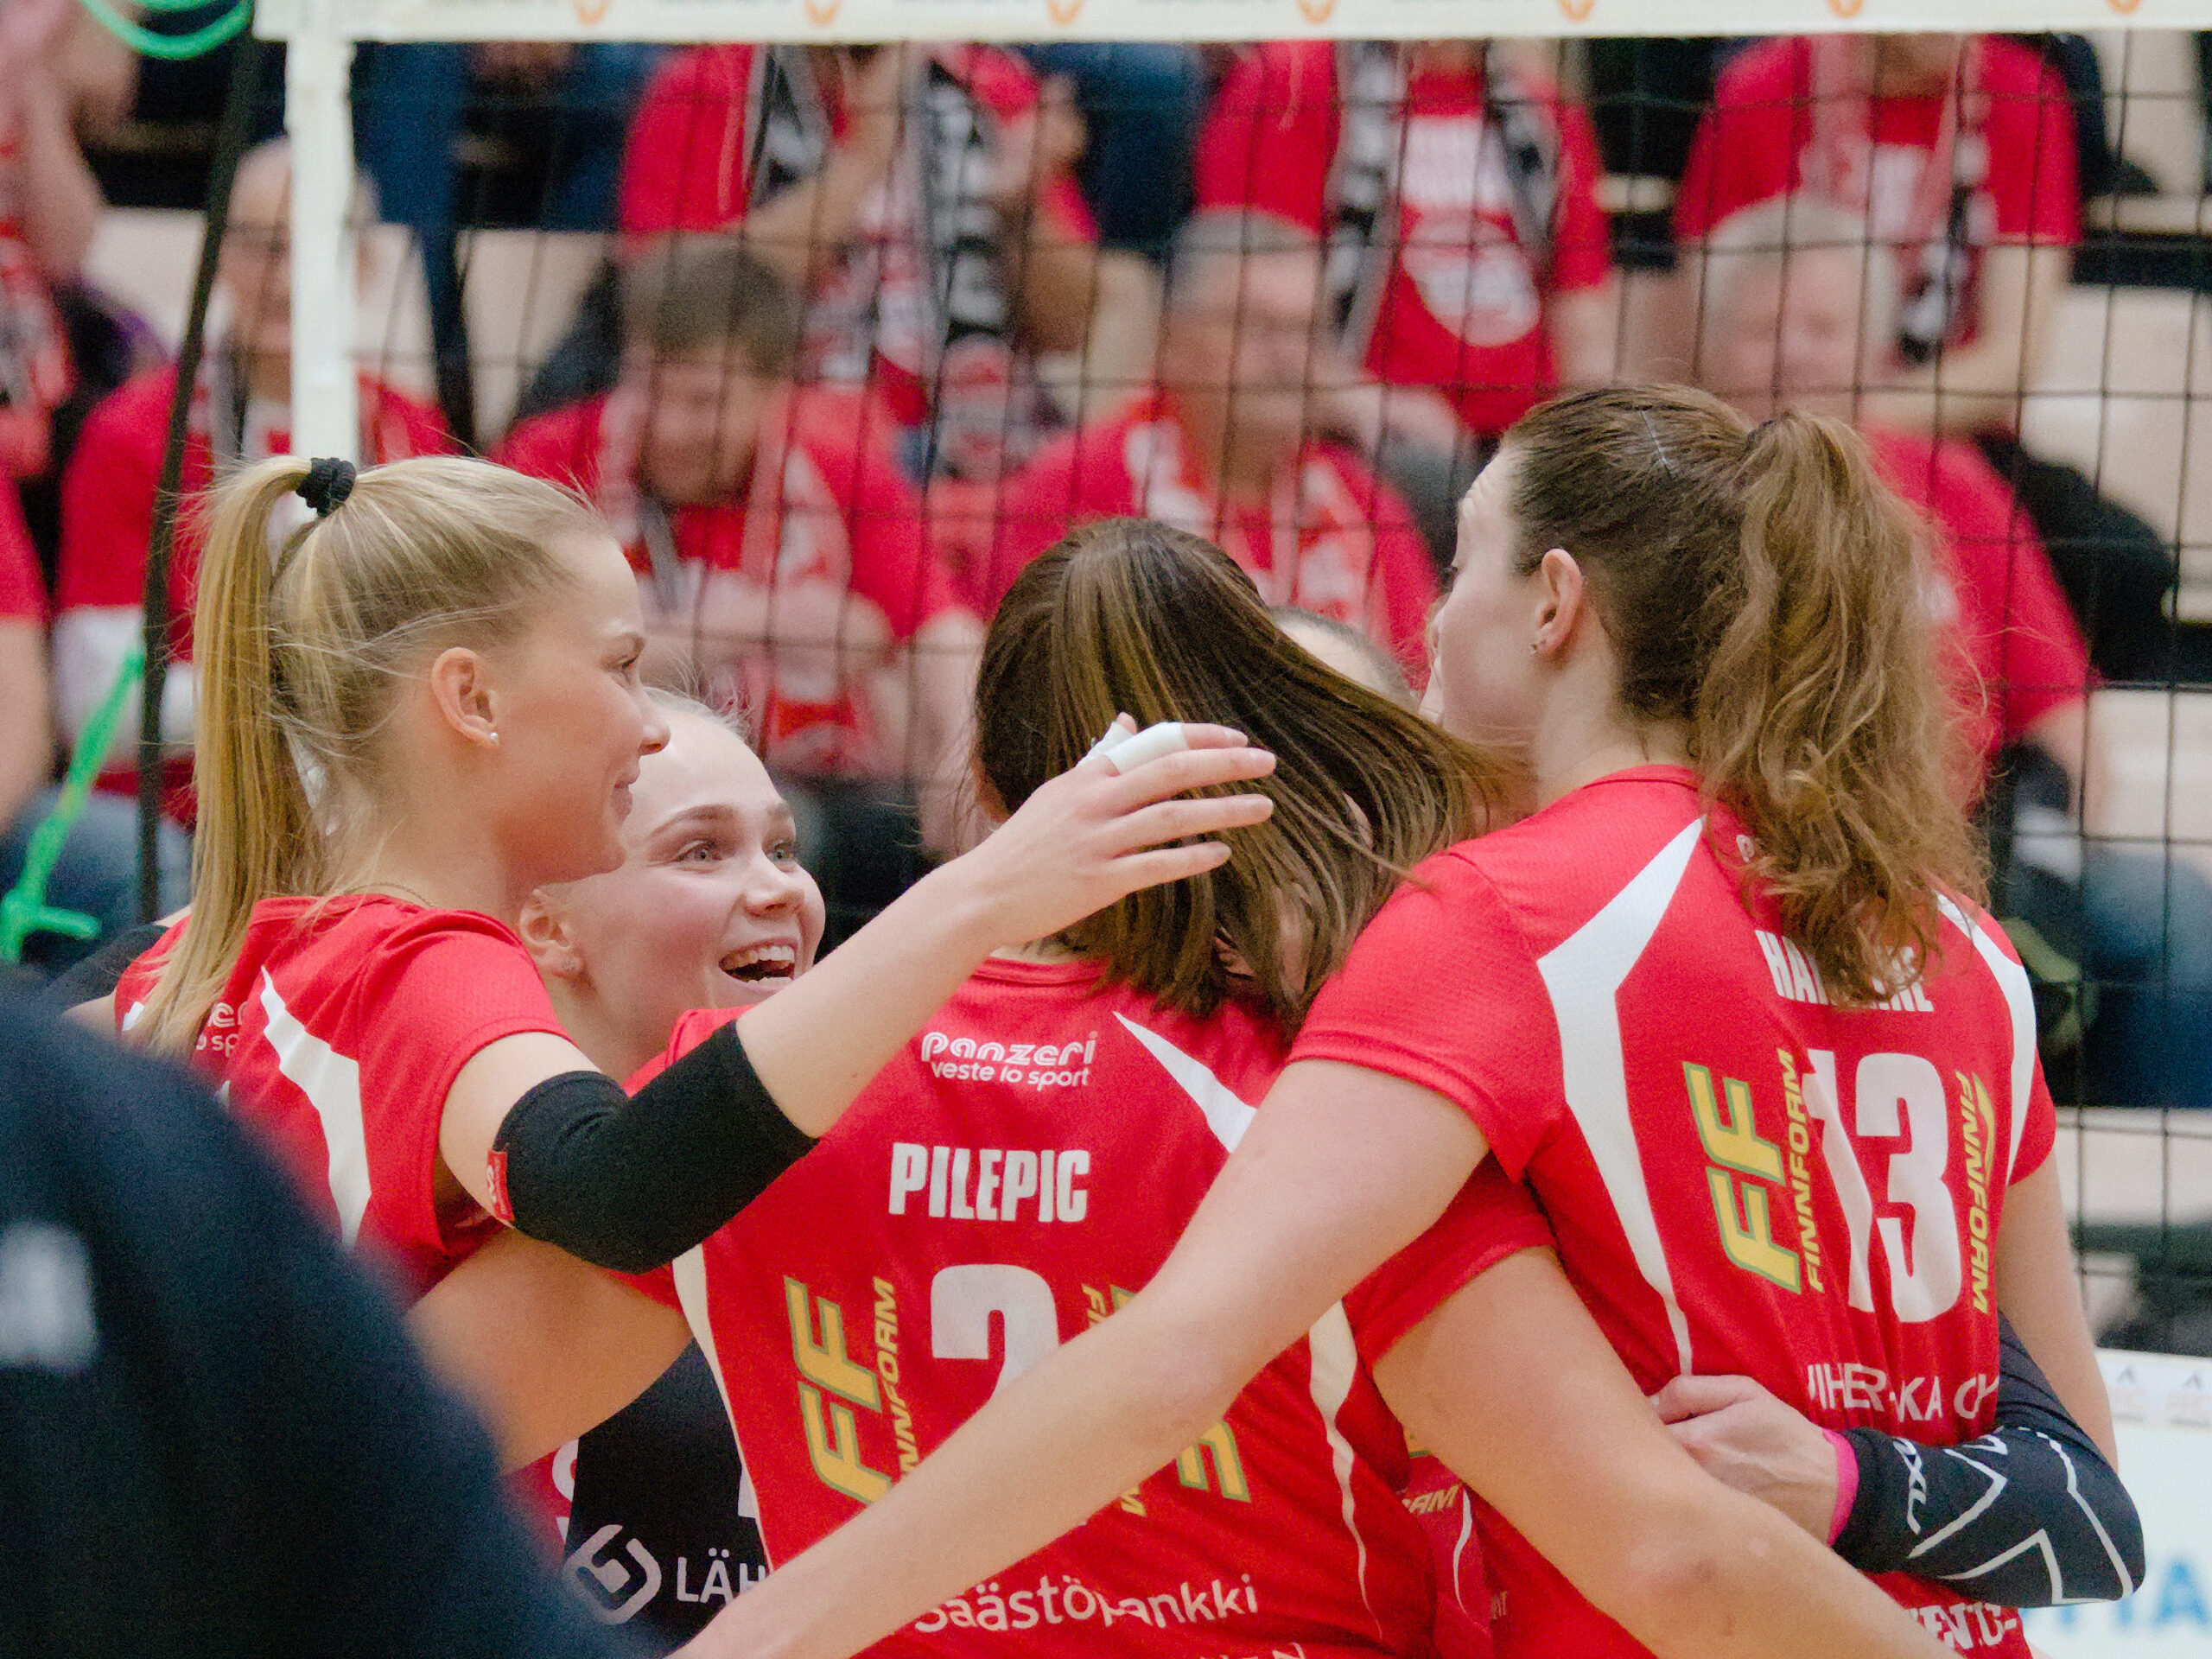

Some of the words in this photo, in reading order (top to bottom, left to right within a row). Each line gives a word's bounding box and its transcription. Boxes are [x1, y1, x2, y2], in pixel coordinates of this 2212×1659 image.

[921, 1031, 1098, 1066] panzeri
[931, 1061, 995, 1081] veste
[1000, 1065, 1023, 1083] lo
[1027, 1067, 1090, 1091] sport
[888, 1142, 1090, 1223] PILEPIC
[1776, 1047, 1825, 1294] FINNFORM
[1802, 1049, 1961, 1323] 13
[1955, 1069, 1989, 1314] FINNFORM
[873, 1276, 919, 1473] NNFORM
